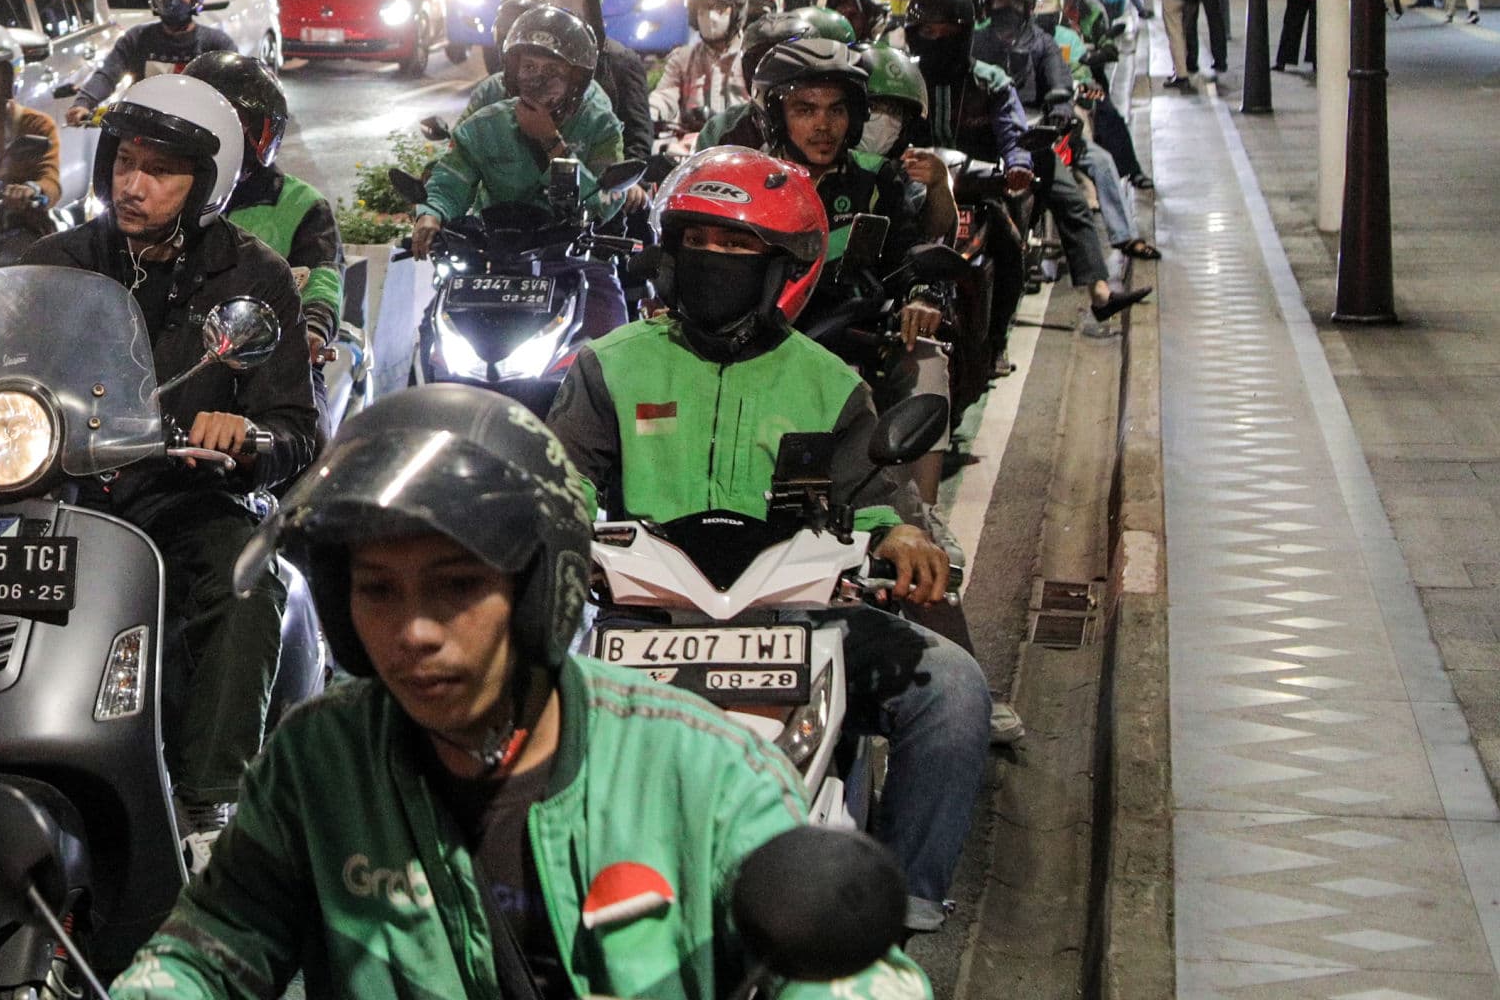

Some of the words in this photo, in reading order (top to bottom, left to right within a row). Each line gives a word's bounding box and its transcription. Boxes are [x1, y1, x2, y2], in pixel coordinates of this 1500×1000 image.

[693, 184, 743, 198] INK
[453, 278, 465, 290] B
[472, 278, 511, 290] 3347
[521, 279, 549, 291] SVR
[702, 517, 745, 526] HONDA
[23, 545, 68, 572] TGI
[608, 637, 624, 662] B
[642, 635, 720, 662] 4407
[738, 634, 793, 660] TWI
[342, 853, 435, 914] Grab
